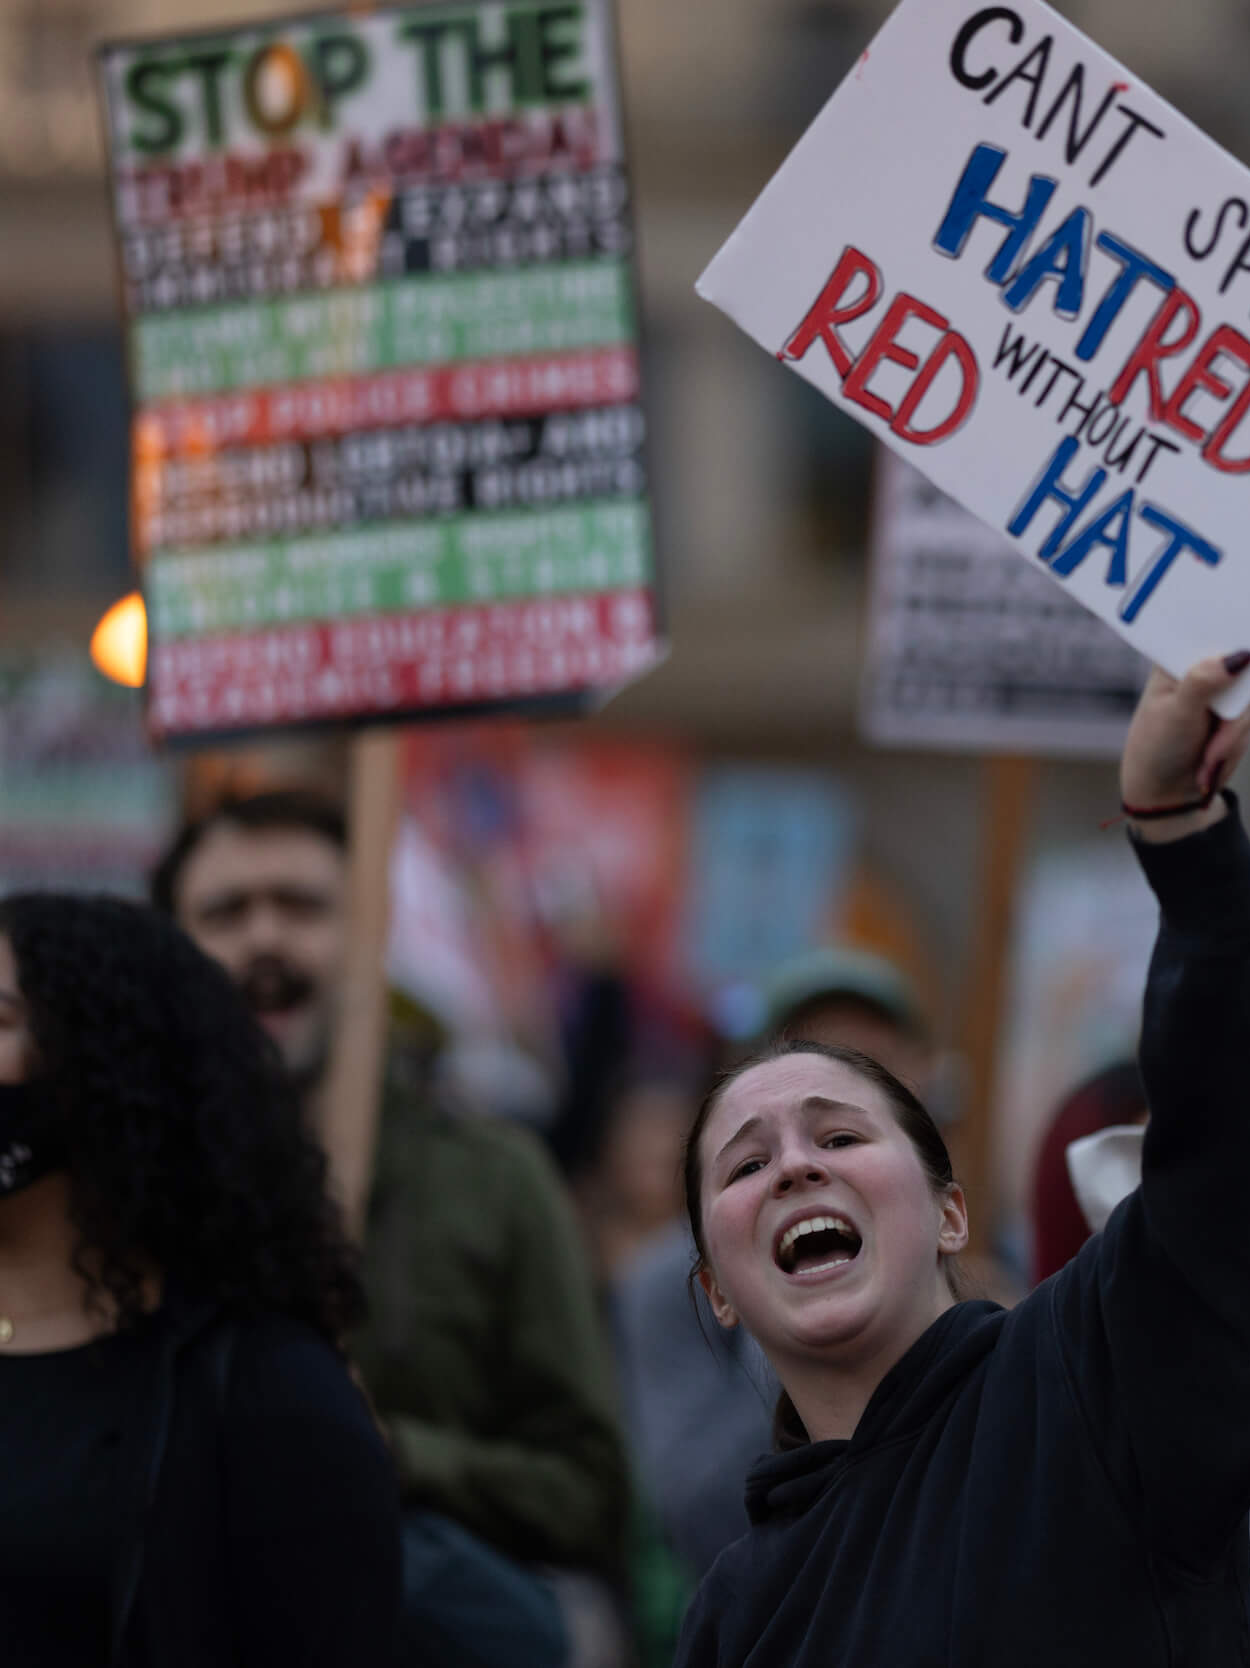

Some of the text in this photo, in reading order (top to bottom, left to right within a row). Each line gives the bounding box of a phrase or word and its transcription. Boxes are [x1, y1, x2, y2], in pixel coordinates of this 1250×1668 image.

[127, 6, 591, 155] STOP THE
[949, 6, 1165, 187] CANT
[777, 245, 1223, 625] RED HAT
[992, 322, 1182, 484] WITHOUT
